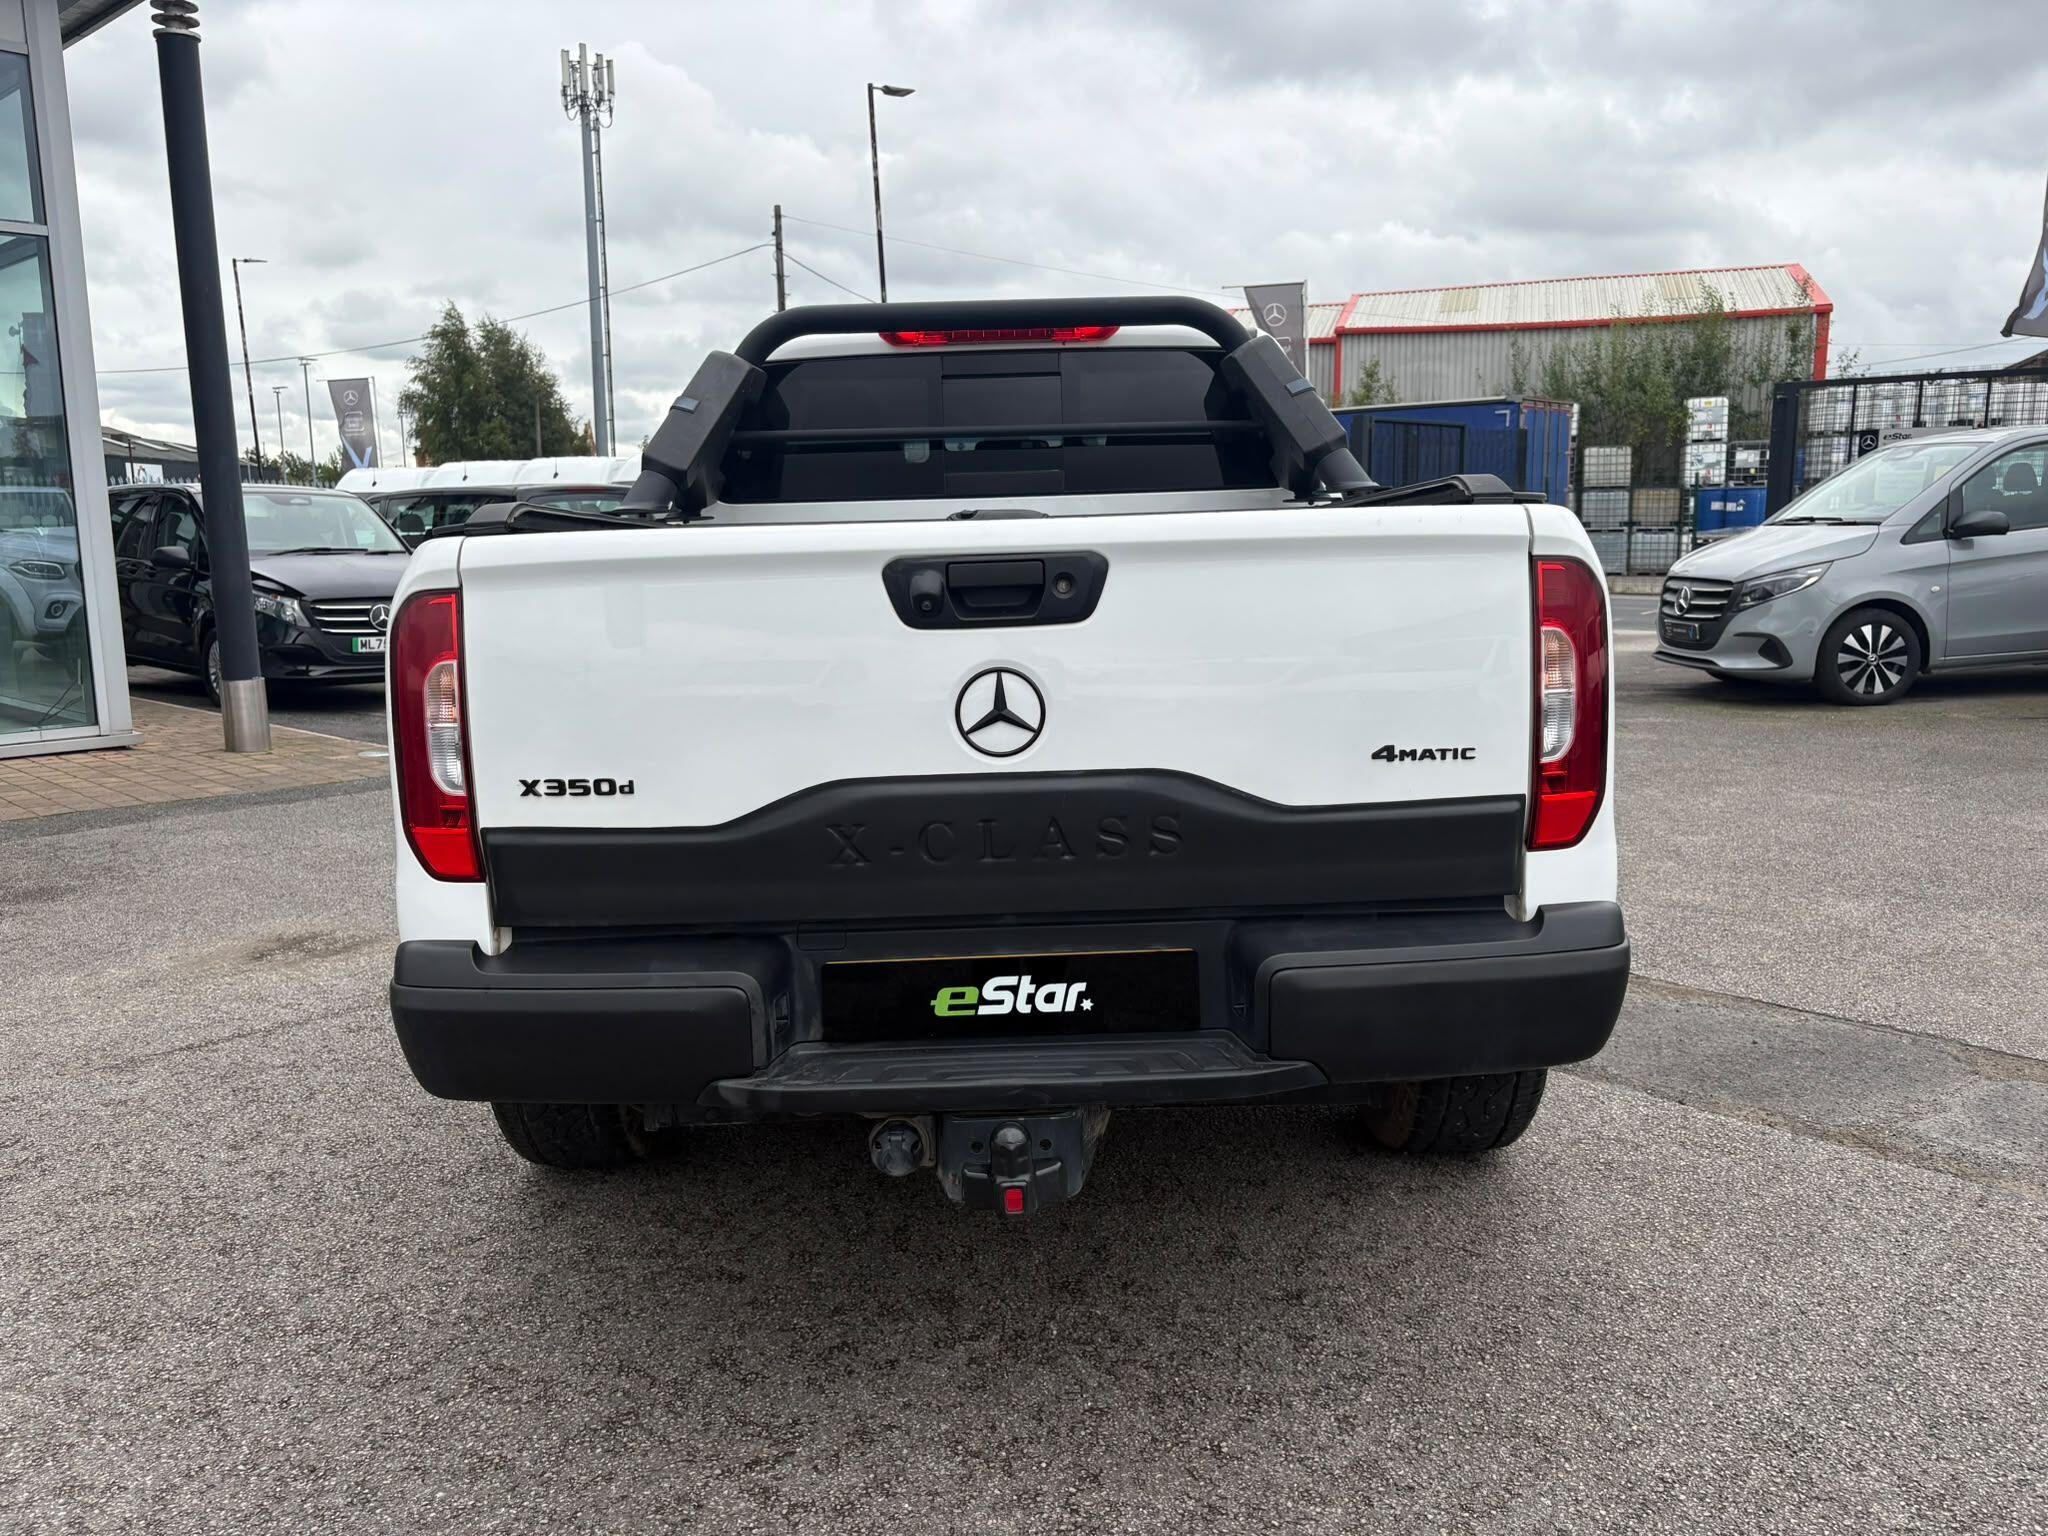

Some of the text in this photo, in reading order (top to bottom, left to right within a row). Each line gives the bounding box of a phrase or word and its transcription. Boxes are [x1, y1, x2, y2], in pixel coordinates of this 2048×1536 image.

[360, 638, 386, 650] ML7
[1371, 744, 1476, 762] 4MATIC
[518, 778, 635, 797] X350d
[825, 815, 1184, 868] X-CLASS
